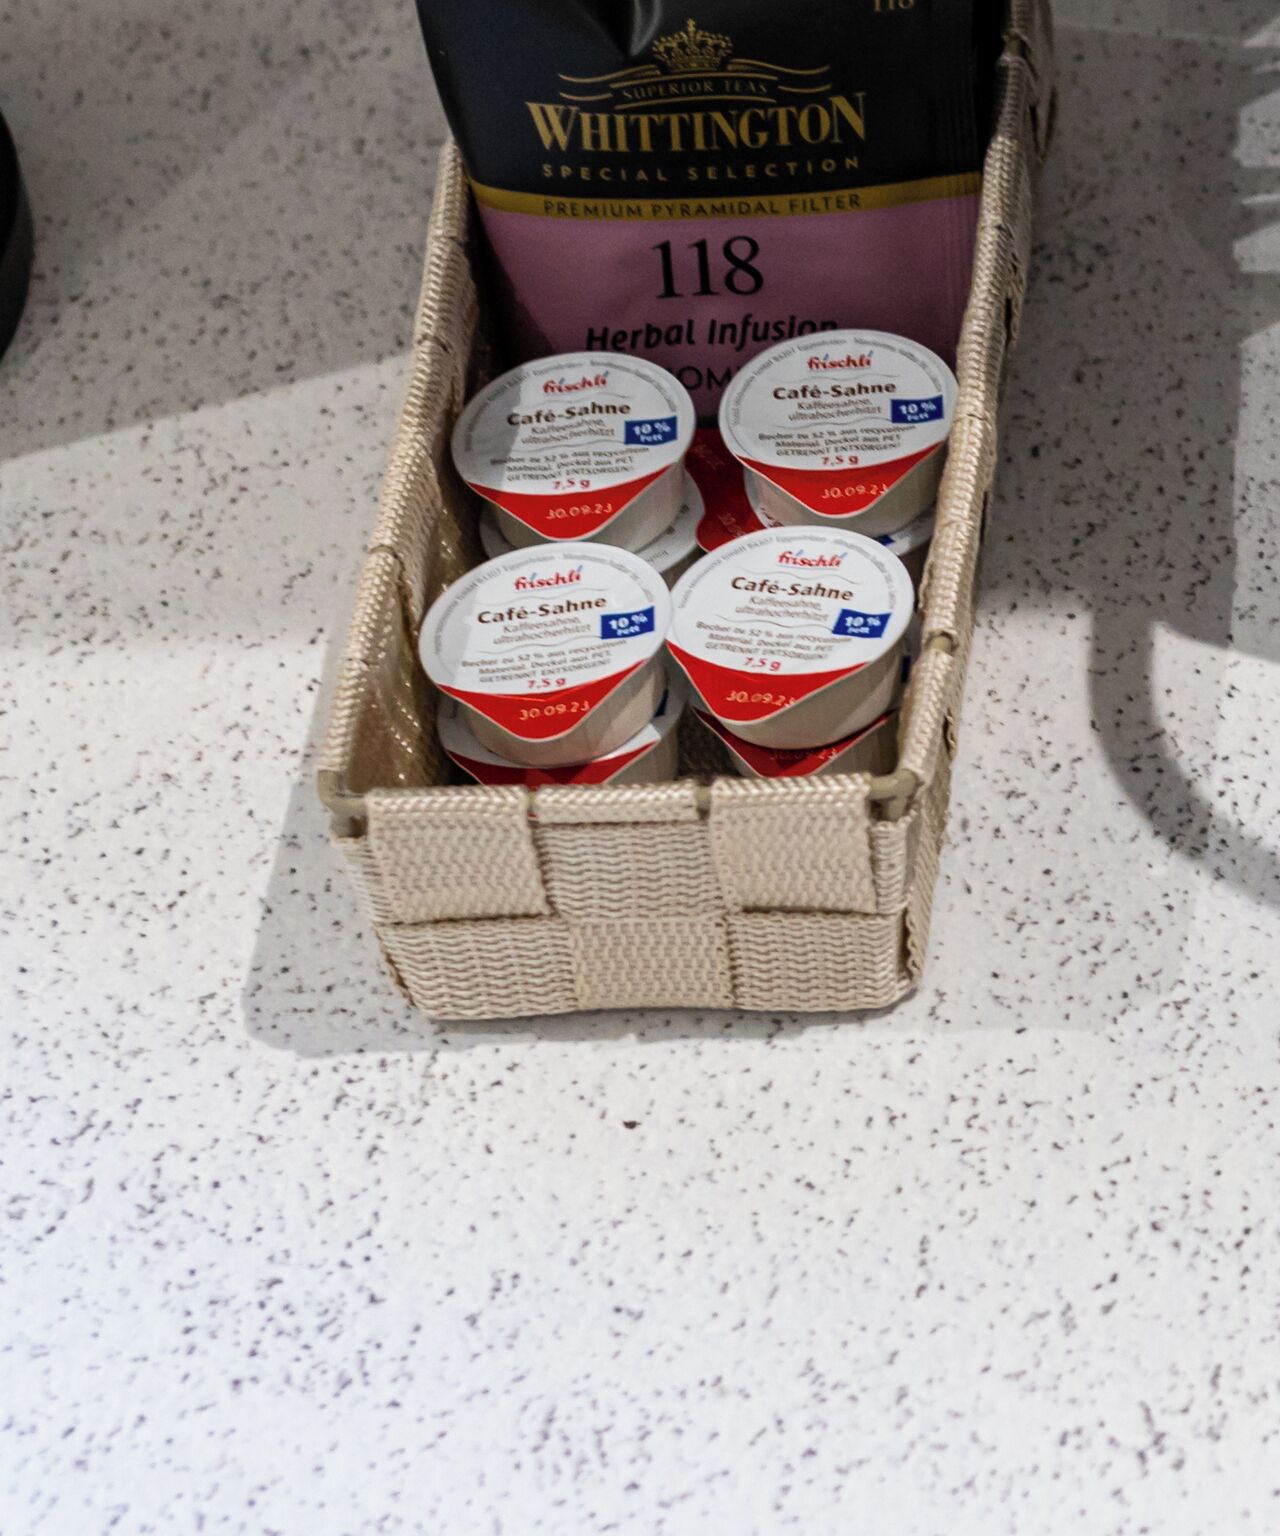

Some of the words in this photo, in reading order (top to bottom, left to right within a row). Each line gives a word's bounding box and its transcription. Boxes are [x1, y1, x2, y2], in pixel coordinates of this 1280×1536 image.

[622, 80, 714, 101] SUPERIOR
[725, 79, 768, 95] TEAS
[524, 92, 867, 152] WHITTINGTON
[542, 163, 668, 182] SPECIAL
[688, 156, 860, 181] SELECTION
[543, 199, 644, 219] PREMIUM
[651, 199, 780, 217] PYRAMIDAL
[789, 194, 861, 213] FILTER
[651, 235, 764, 301] 118
[585, 314, 695, 353] Herbal
[807, 350, 874, 371] frischli
[542, 370, 610, 394] frischli
[773, 382, 897, 400] Café-Sahne
[507, 402, 631, 426] Café-Sahne
[821, 455, 844, 466] 7,5
[552, 478, 575, 490] 7,5
[821, 483, 889, 500] 30.09.23
[777, 549, 848, 568] frischli
[513, 565, 583, 592] frischli
[731, 576, 854, 602] Café-Sahne
[477, 596, 608, 624] Café-Sahne
[743, 657, 766, 668] 7,5
[527, 677, 550, 689] 7,5
[725, 690, 799, 709] 30.09.23
[519, 701, 590, 721] 30.09.23
